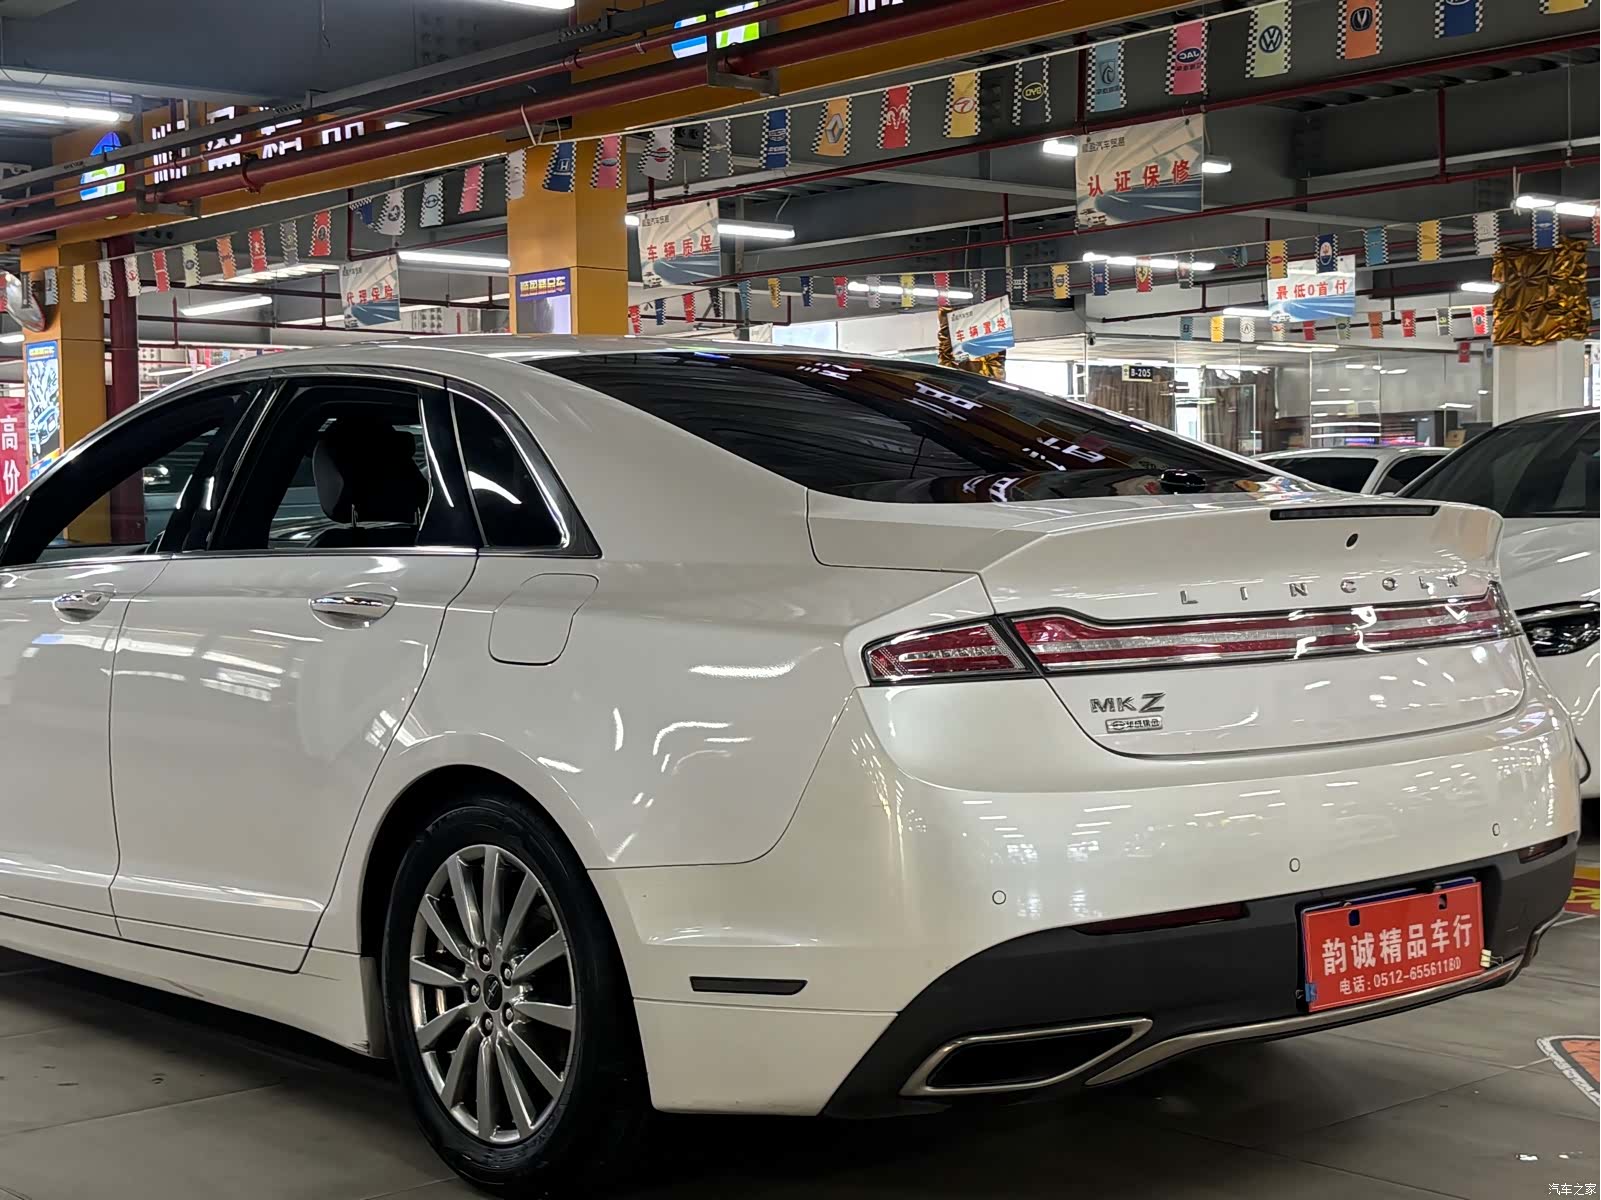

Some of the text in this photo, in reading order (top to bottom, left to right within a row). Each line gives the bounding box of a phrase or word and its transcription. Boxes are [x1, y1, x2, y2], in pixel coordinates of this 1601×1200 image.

[1087, 160, 1191, 198] 认证保修
[647, 235, 713, 262] 车辆质保
[346, 284, 393, 306] 代理保险
[1276, 280, 1347, 301] 最低0首付
[955, 317, 1007, 342] 车辆置换
[1130, 368, 1152, 378] B-205
[1180, 575, 1460, 605] LINCOLN
[1089, 692, 1166, 713] MKZ
[1321, 914, 1473, 976] 韵诚精品车行
